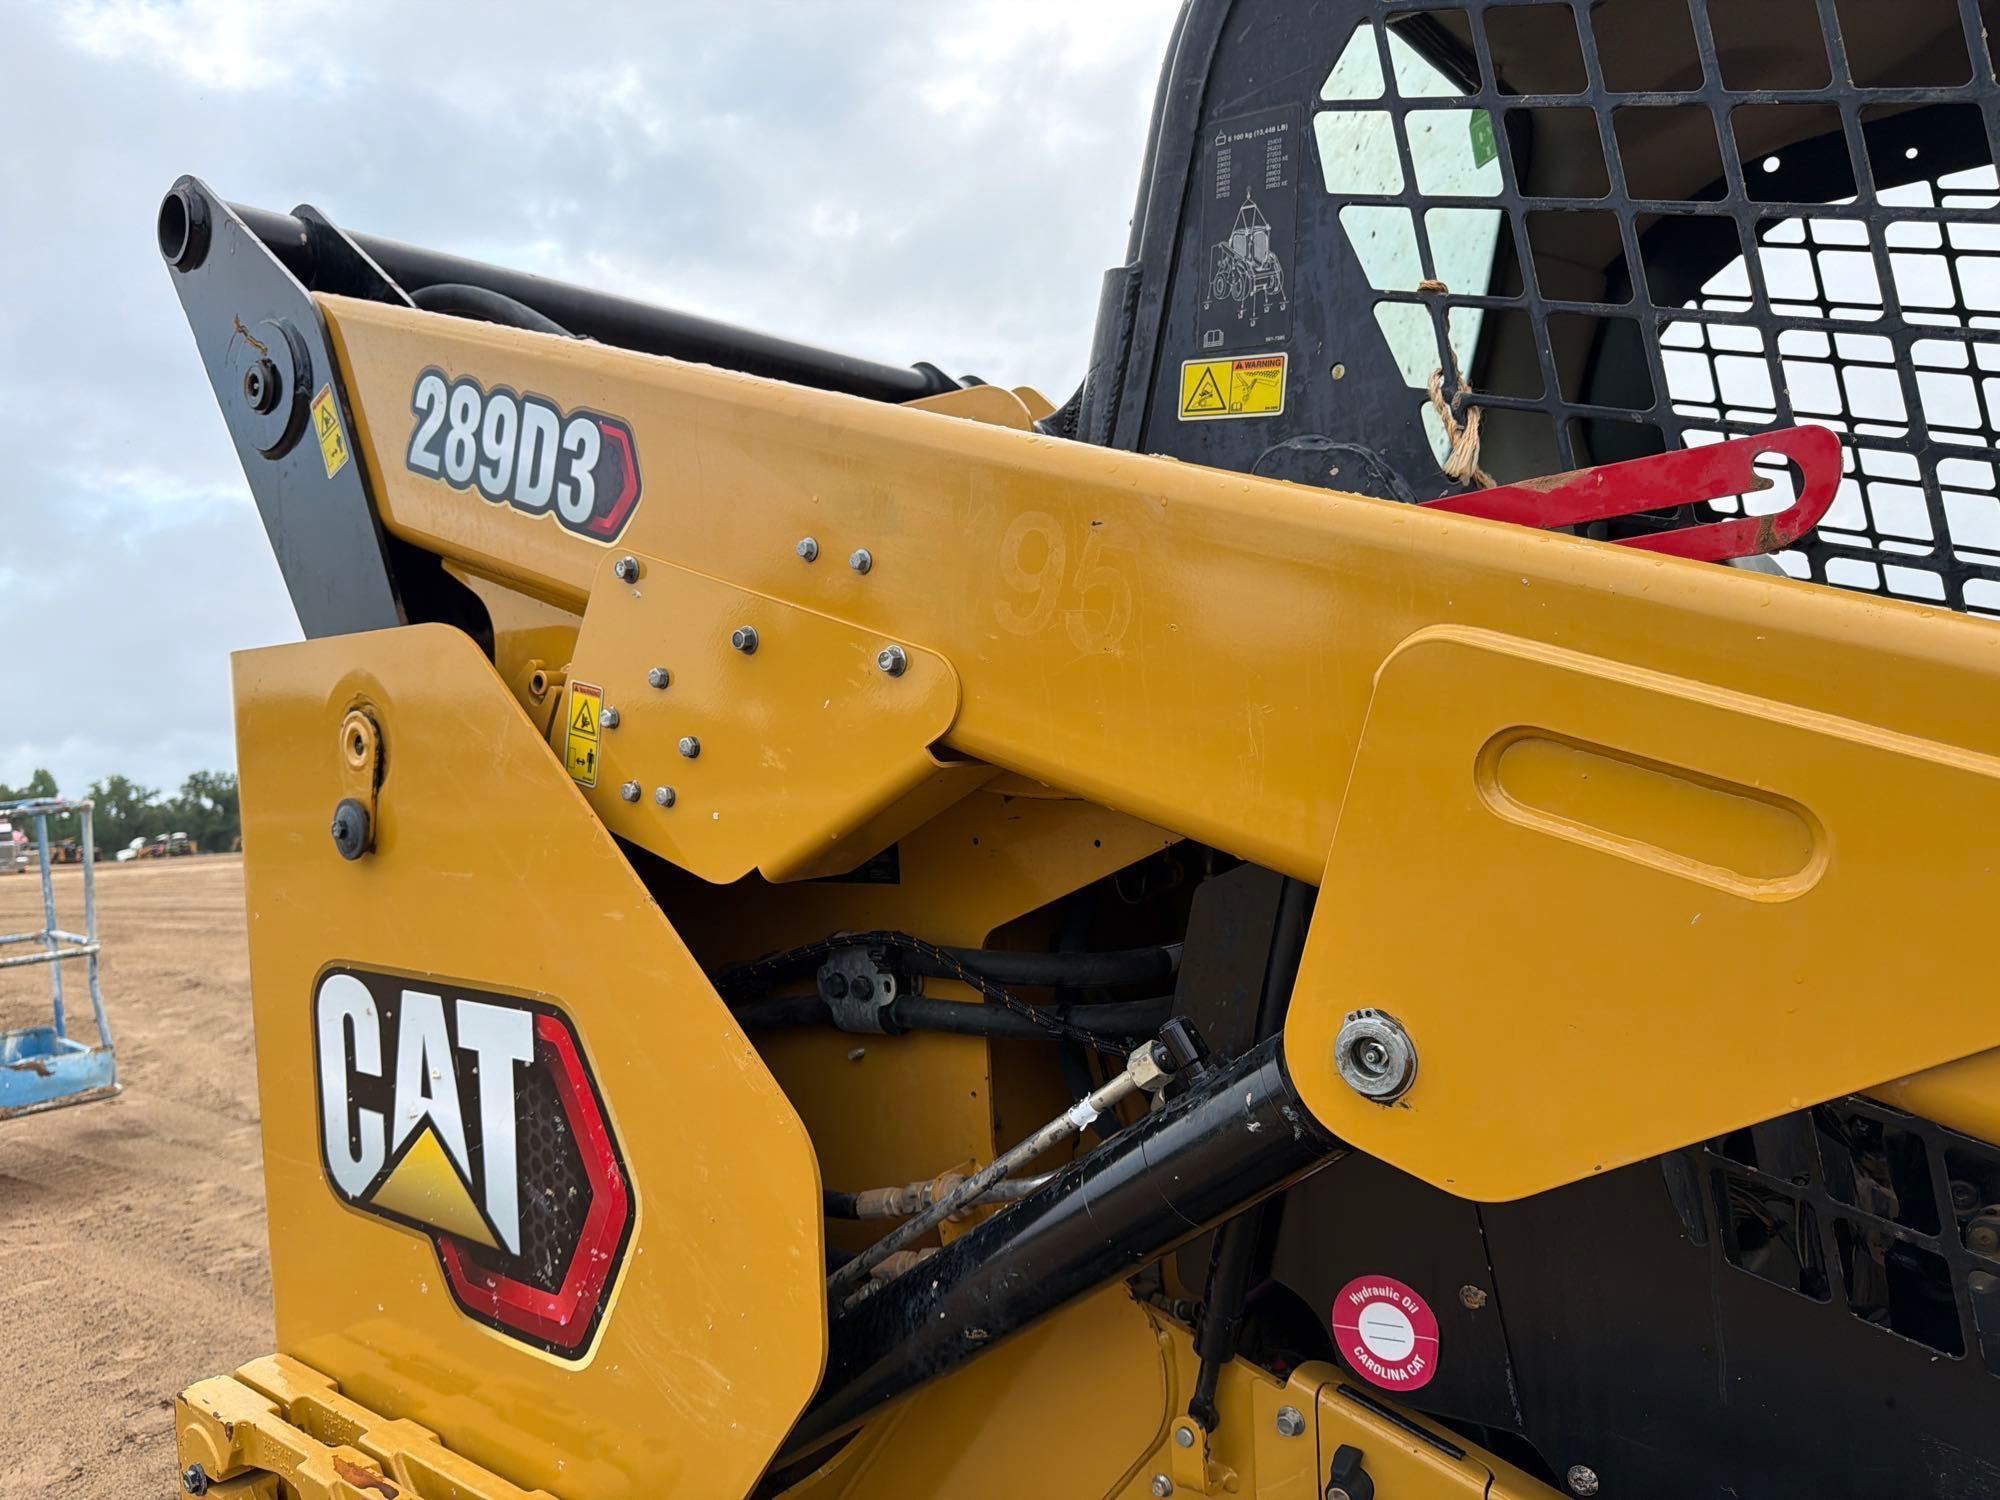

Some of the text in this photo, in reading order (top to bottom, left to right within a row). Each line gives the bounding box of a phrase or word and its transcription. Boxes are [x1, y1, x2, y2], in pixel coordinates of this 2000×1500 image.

[1244, 359, 1281, 369] WARNING
[410, 375, 601, 524] 289D3
[317, 974, 534, 1257] CAT
[1349, 1286, 1419, 1314] Hydraulic Oil
[1354, 1346, 1425, 1381] CAROLINA CAT
